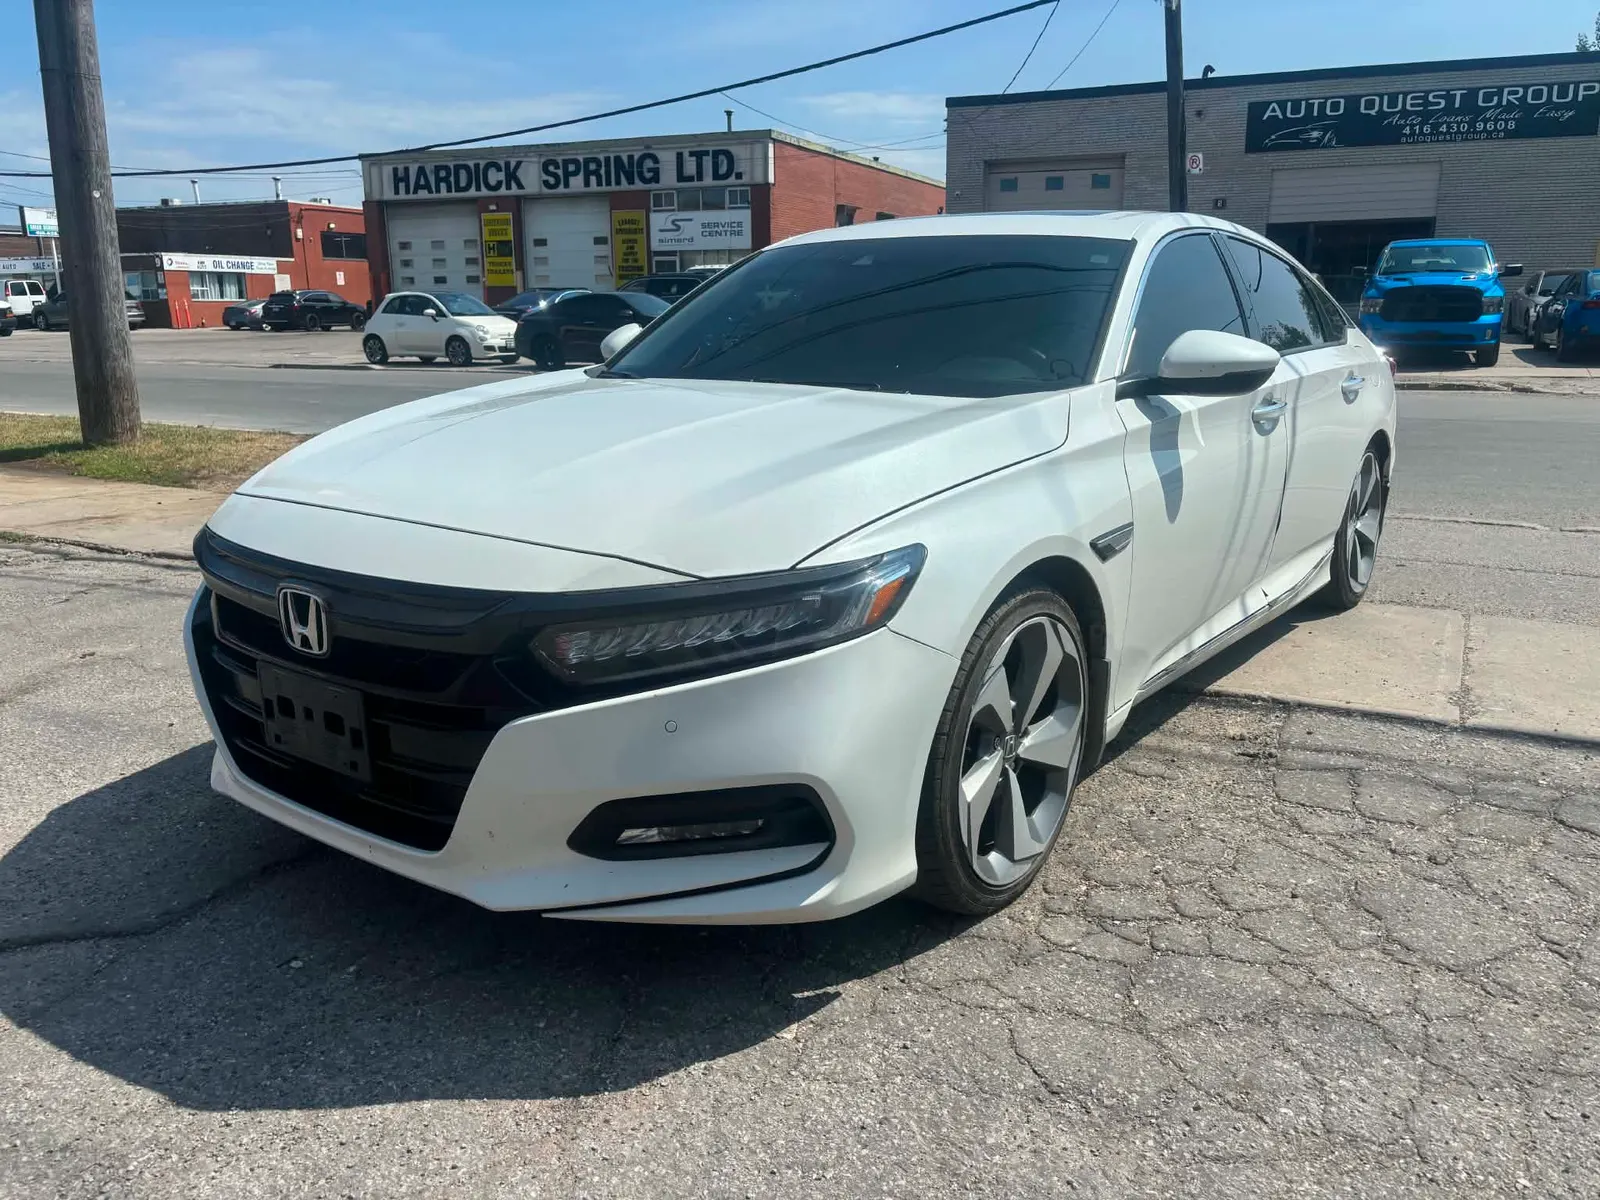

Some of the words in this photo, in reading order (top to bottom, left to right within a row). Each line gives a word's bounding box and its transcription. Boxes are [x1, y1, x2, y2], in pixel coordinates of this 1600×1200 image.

[1262, 98, 1345, 120] AUTO
[1360, 90, 1467, 115] QUEST
[1477, 82, 1600, 107] GROUP
[1382, 113, 1421, 126] Auto
[1429, 111, 1474, 124] Loans
[1479, 108, 1522, 120] Made
[1534, 105, 1576, 121] Easy
[1402, 120, 1516, 135] 416.430.9608
[1400, 131, 1505, 143] autoquestgroup.ca
[392, 160, 525, 195] HARDICK
[541, 153, 660, 190] SPRING
[676, 149, 743, 183] LTD.
[700, 221, 743, 229] SERVICE
[701, 229, 743, 237] CENTRE
[213, 260, 224, 269] OIL
[226, 260, 254, 270] CHANGE
